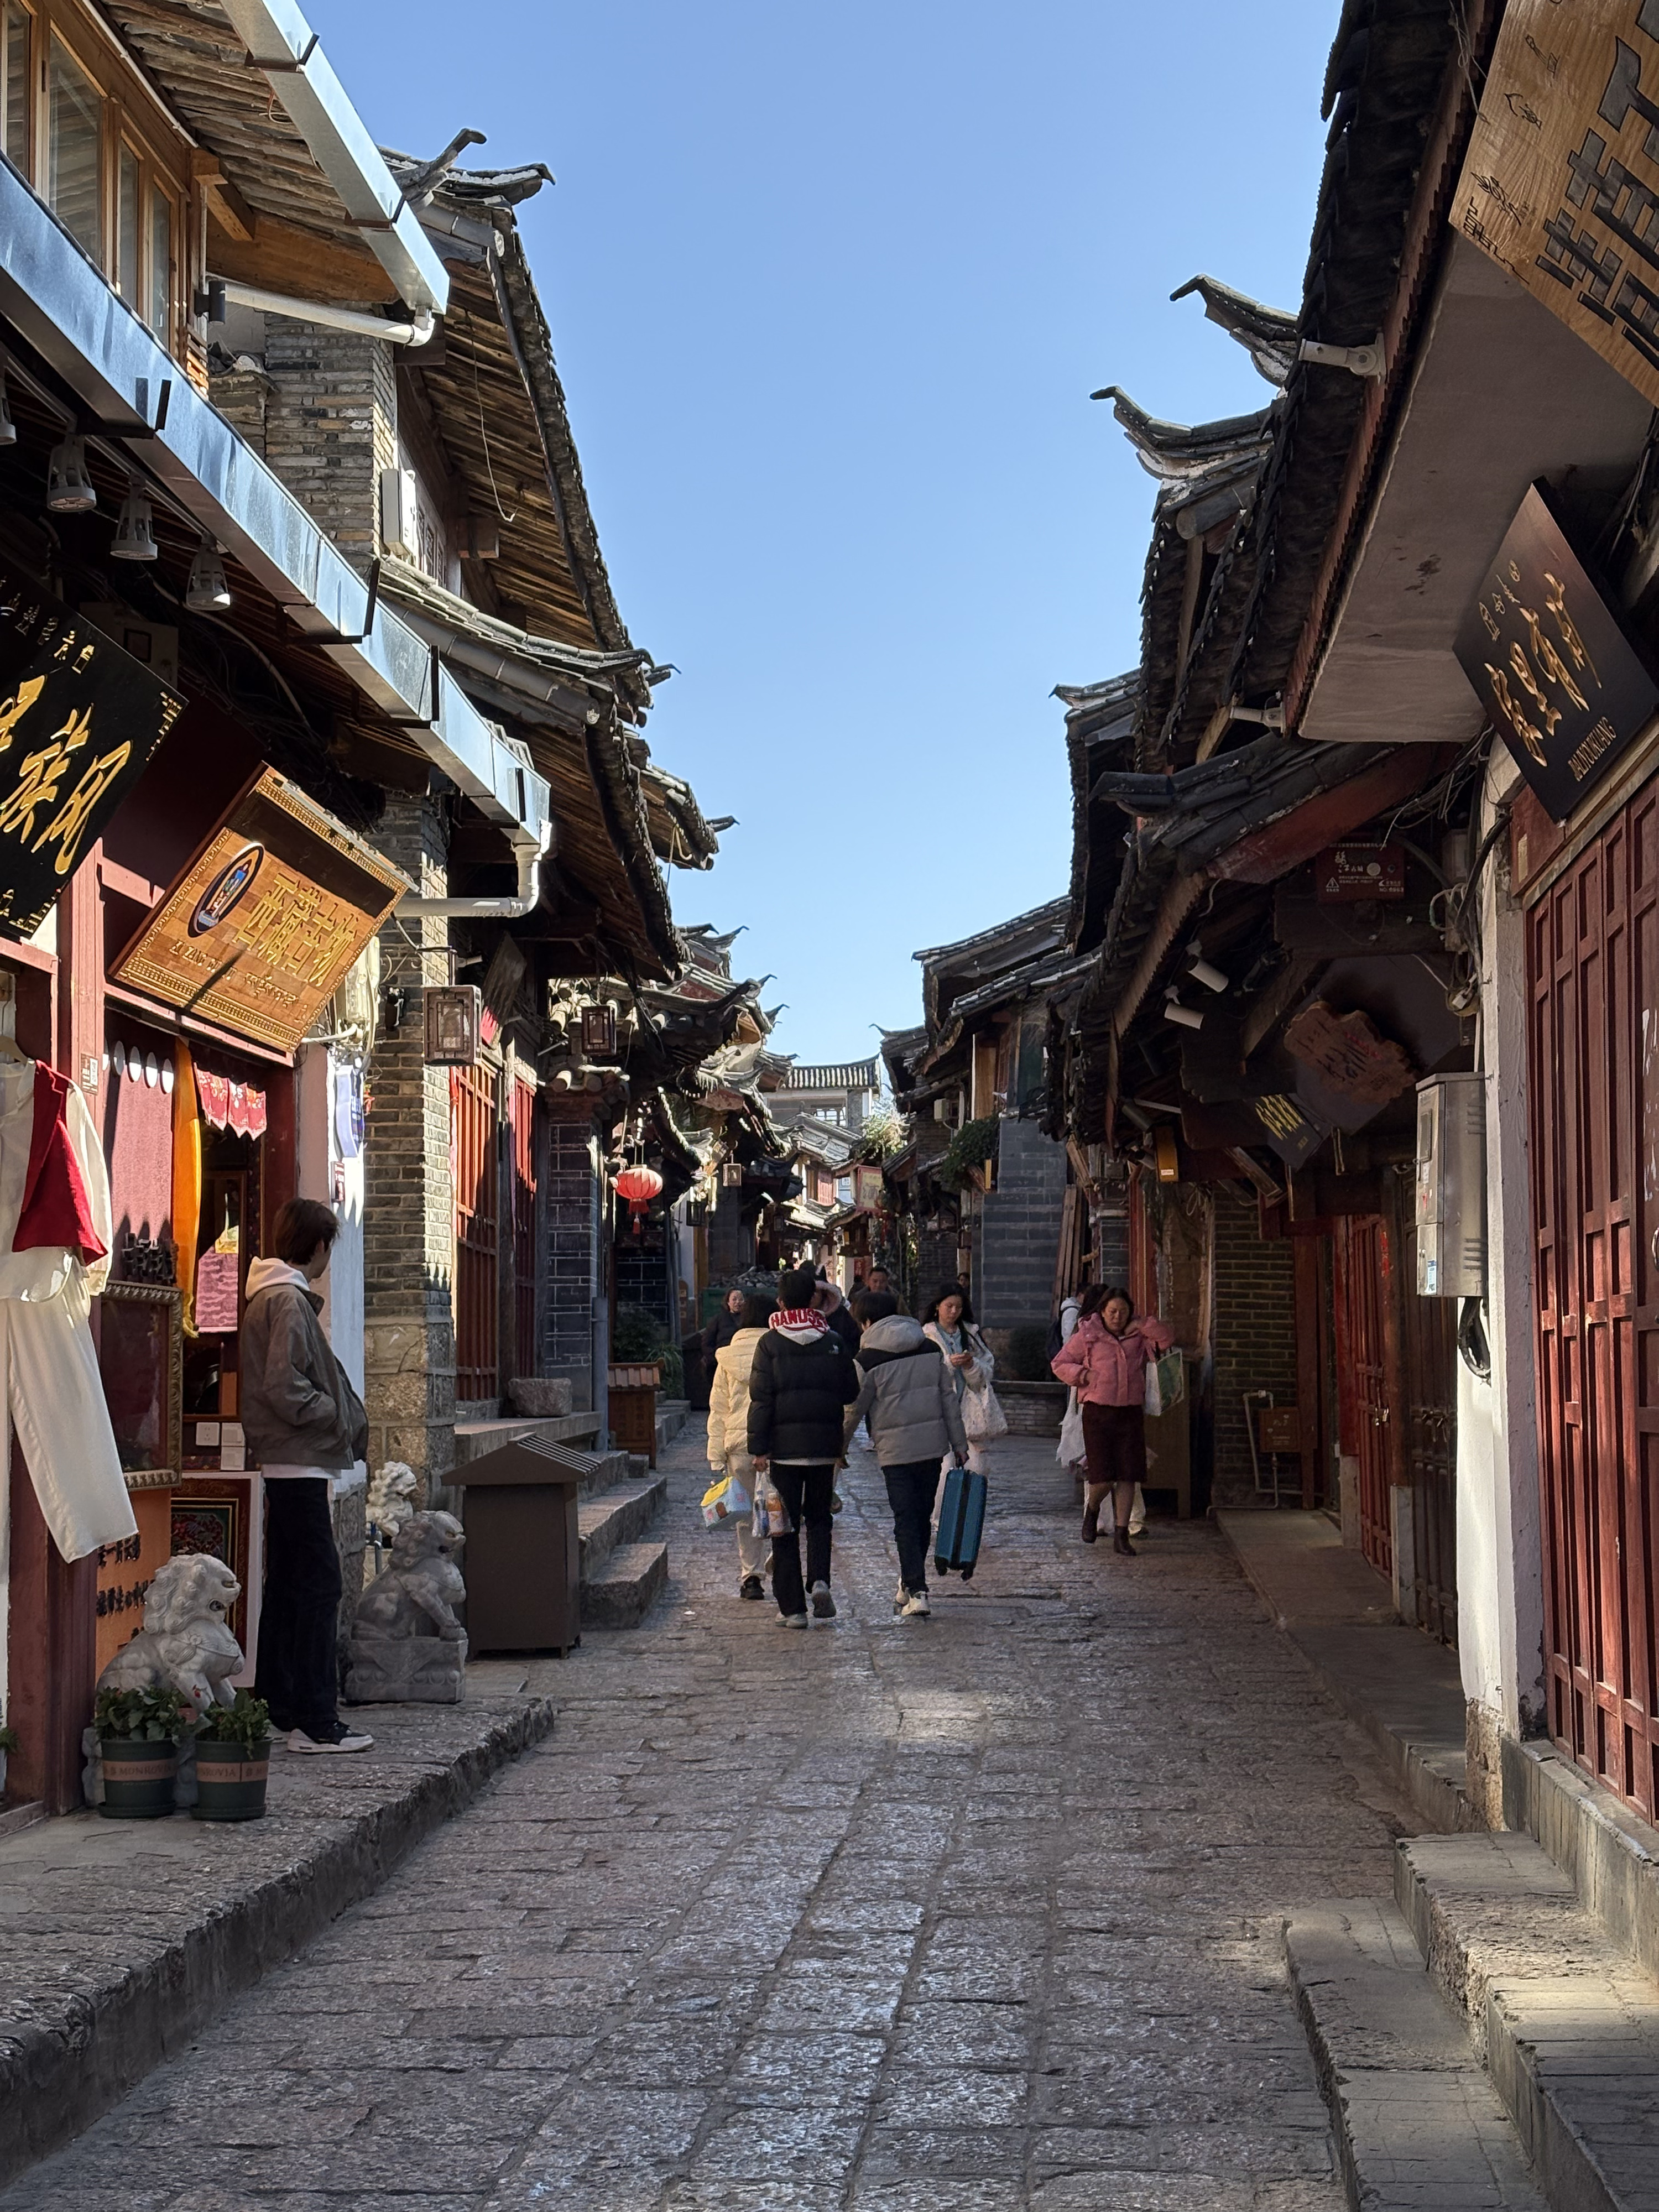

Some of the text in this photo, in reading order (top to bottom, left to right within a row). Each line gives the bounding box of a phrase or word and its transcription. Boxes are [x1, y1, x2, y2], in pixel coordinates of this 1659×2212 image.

[182, 946, 208, 967] ZANG
[232, 872, 358, 987] 西藏古物
